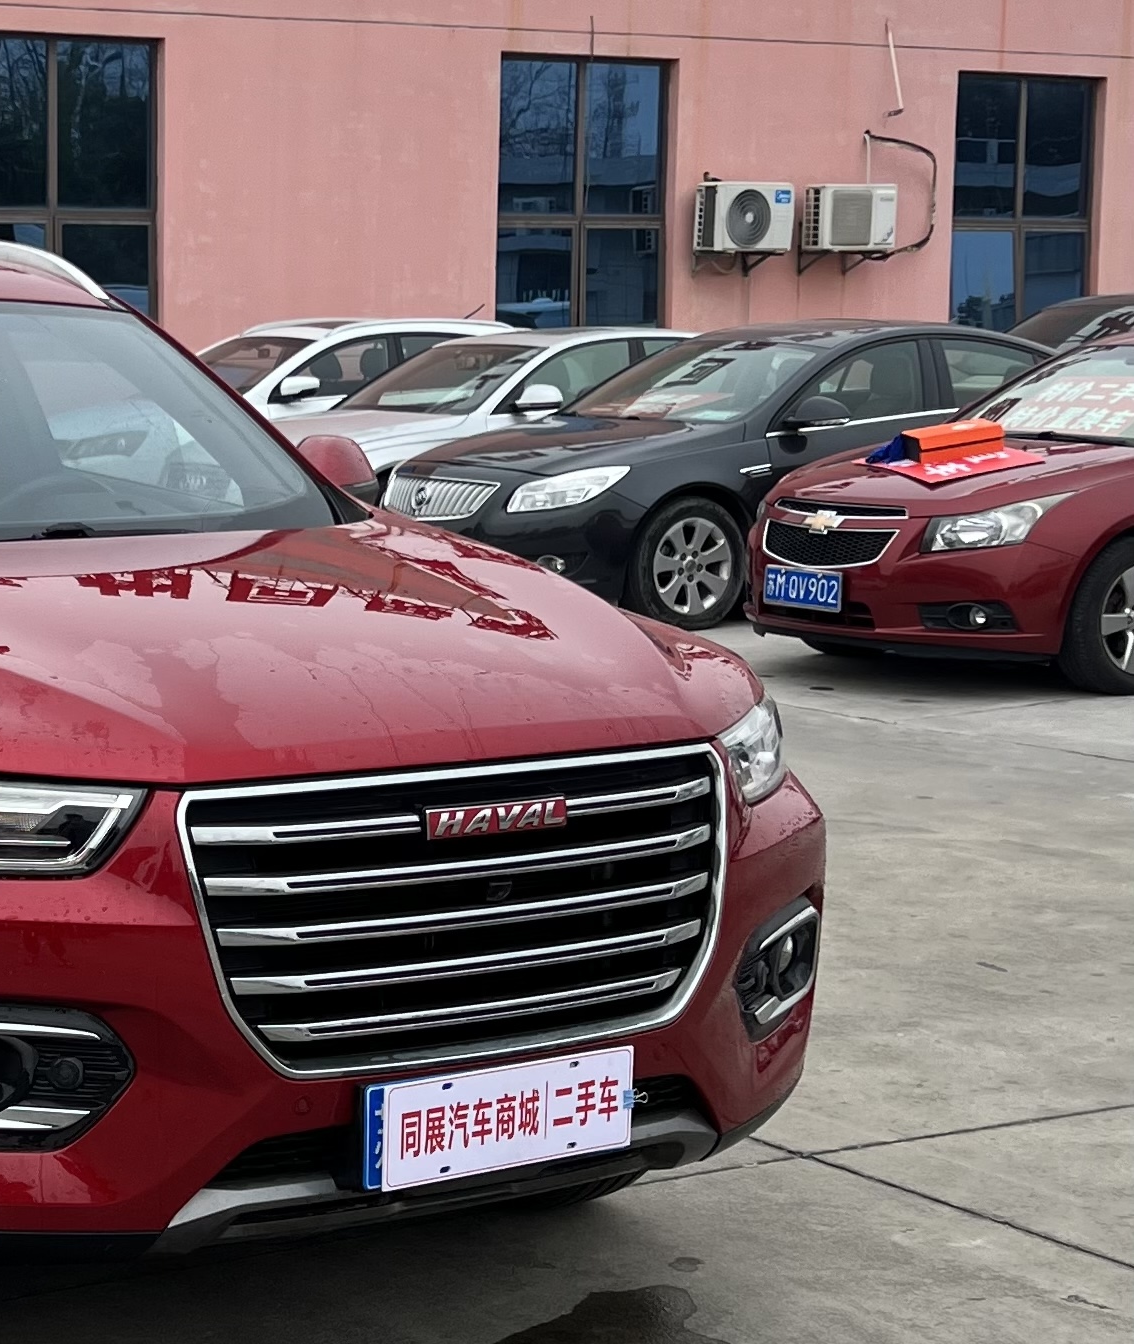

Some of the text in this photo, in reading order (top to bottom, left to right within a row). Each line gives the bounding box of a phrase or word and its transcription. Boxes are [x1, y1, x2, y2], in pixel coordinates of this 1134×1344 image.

[433, 801, 566, 837] HAVAL
[400, 1088, 541, 1160] 同展汽车商城
[552, 1076, 619, 1127] 二手车
